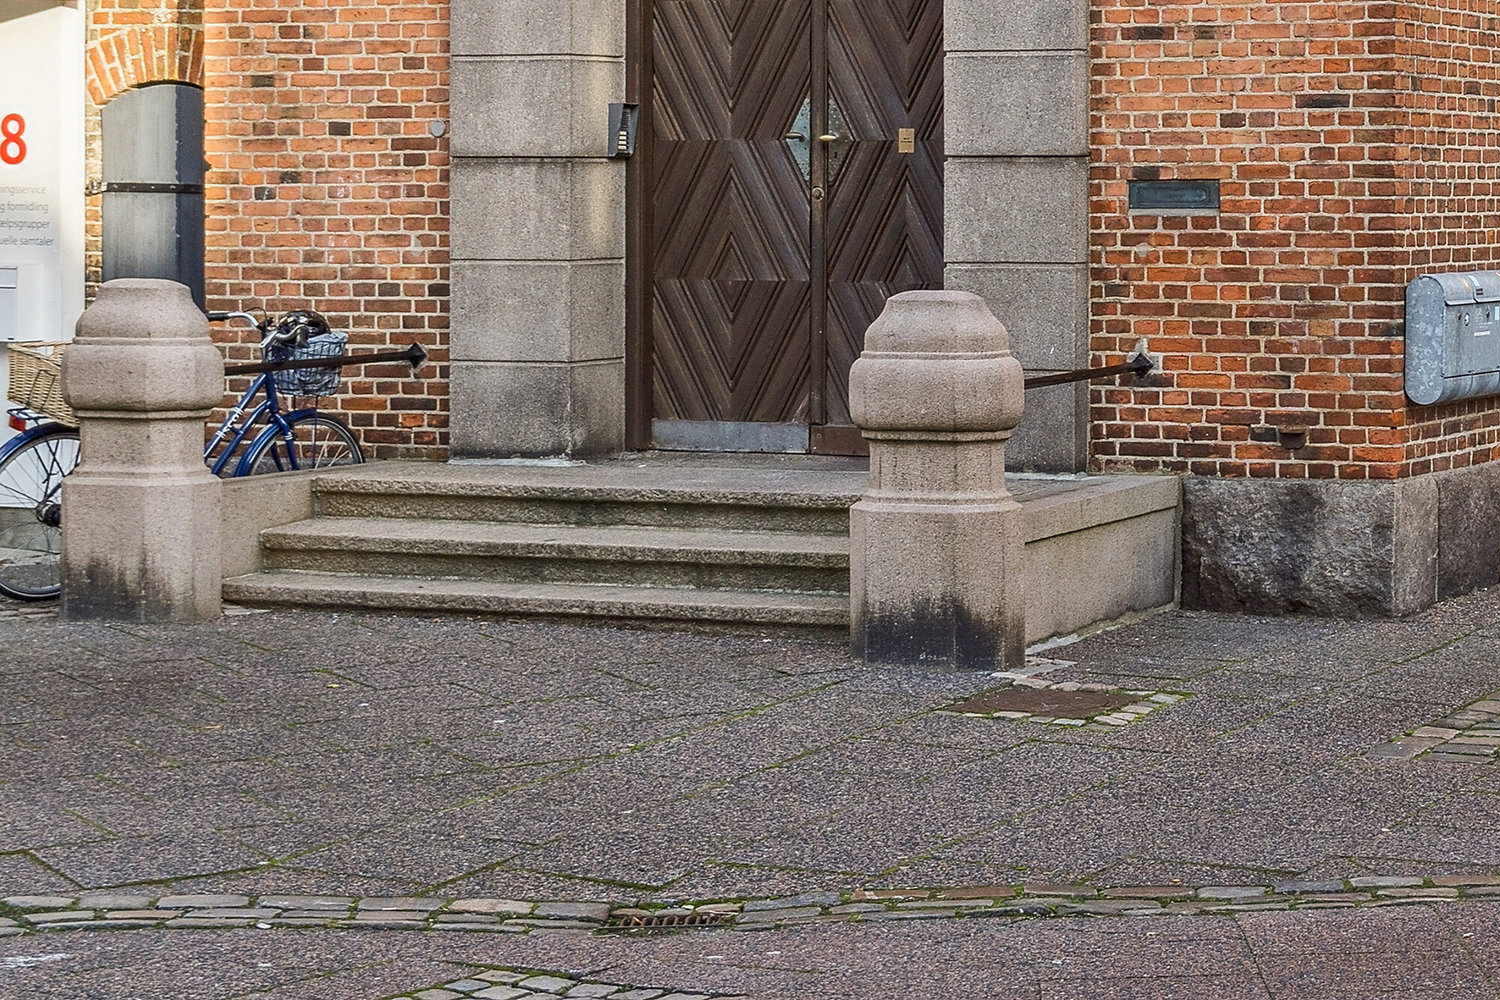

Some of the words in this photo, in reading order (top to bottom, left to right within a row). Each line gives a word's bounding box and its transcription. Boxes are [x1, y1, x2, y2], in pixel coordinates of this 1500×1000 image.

[0, 113, 27, 165] 8
[7, 200, 49, 214] formidling
[19, 236, 54, 247] samtaler
